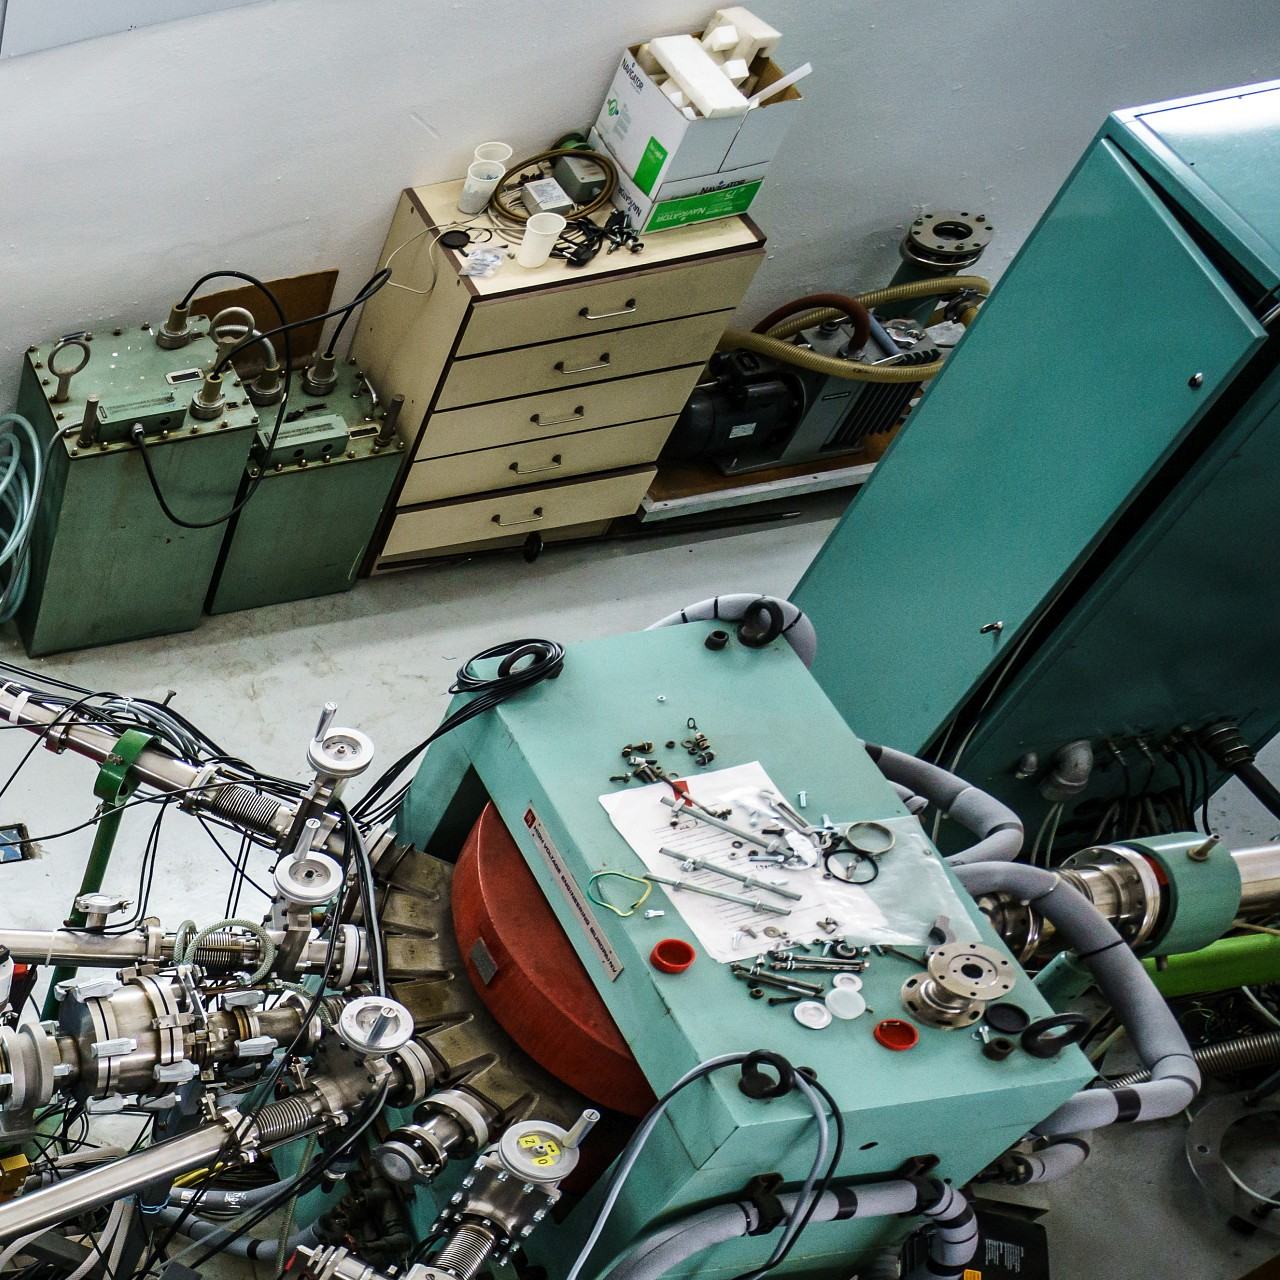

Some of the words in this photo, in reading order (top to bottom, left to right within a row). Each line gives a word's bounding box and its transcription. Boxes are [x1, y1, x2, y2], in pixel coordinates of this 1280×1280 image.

[621, 58, 644, 92] NAVIGATOR
[533, 825, 544, 844] HIGH
[543, 842, 561, 874] VOLTAGE
[560, 874, 590, 926] ENGINEERING
